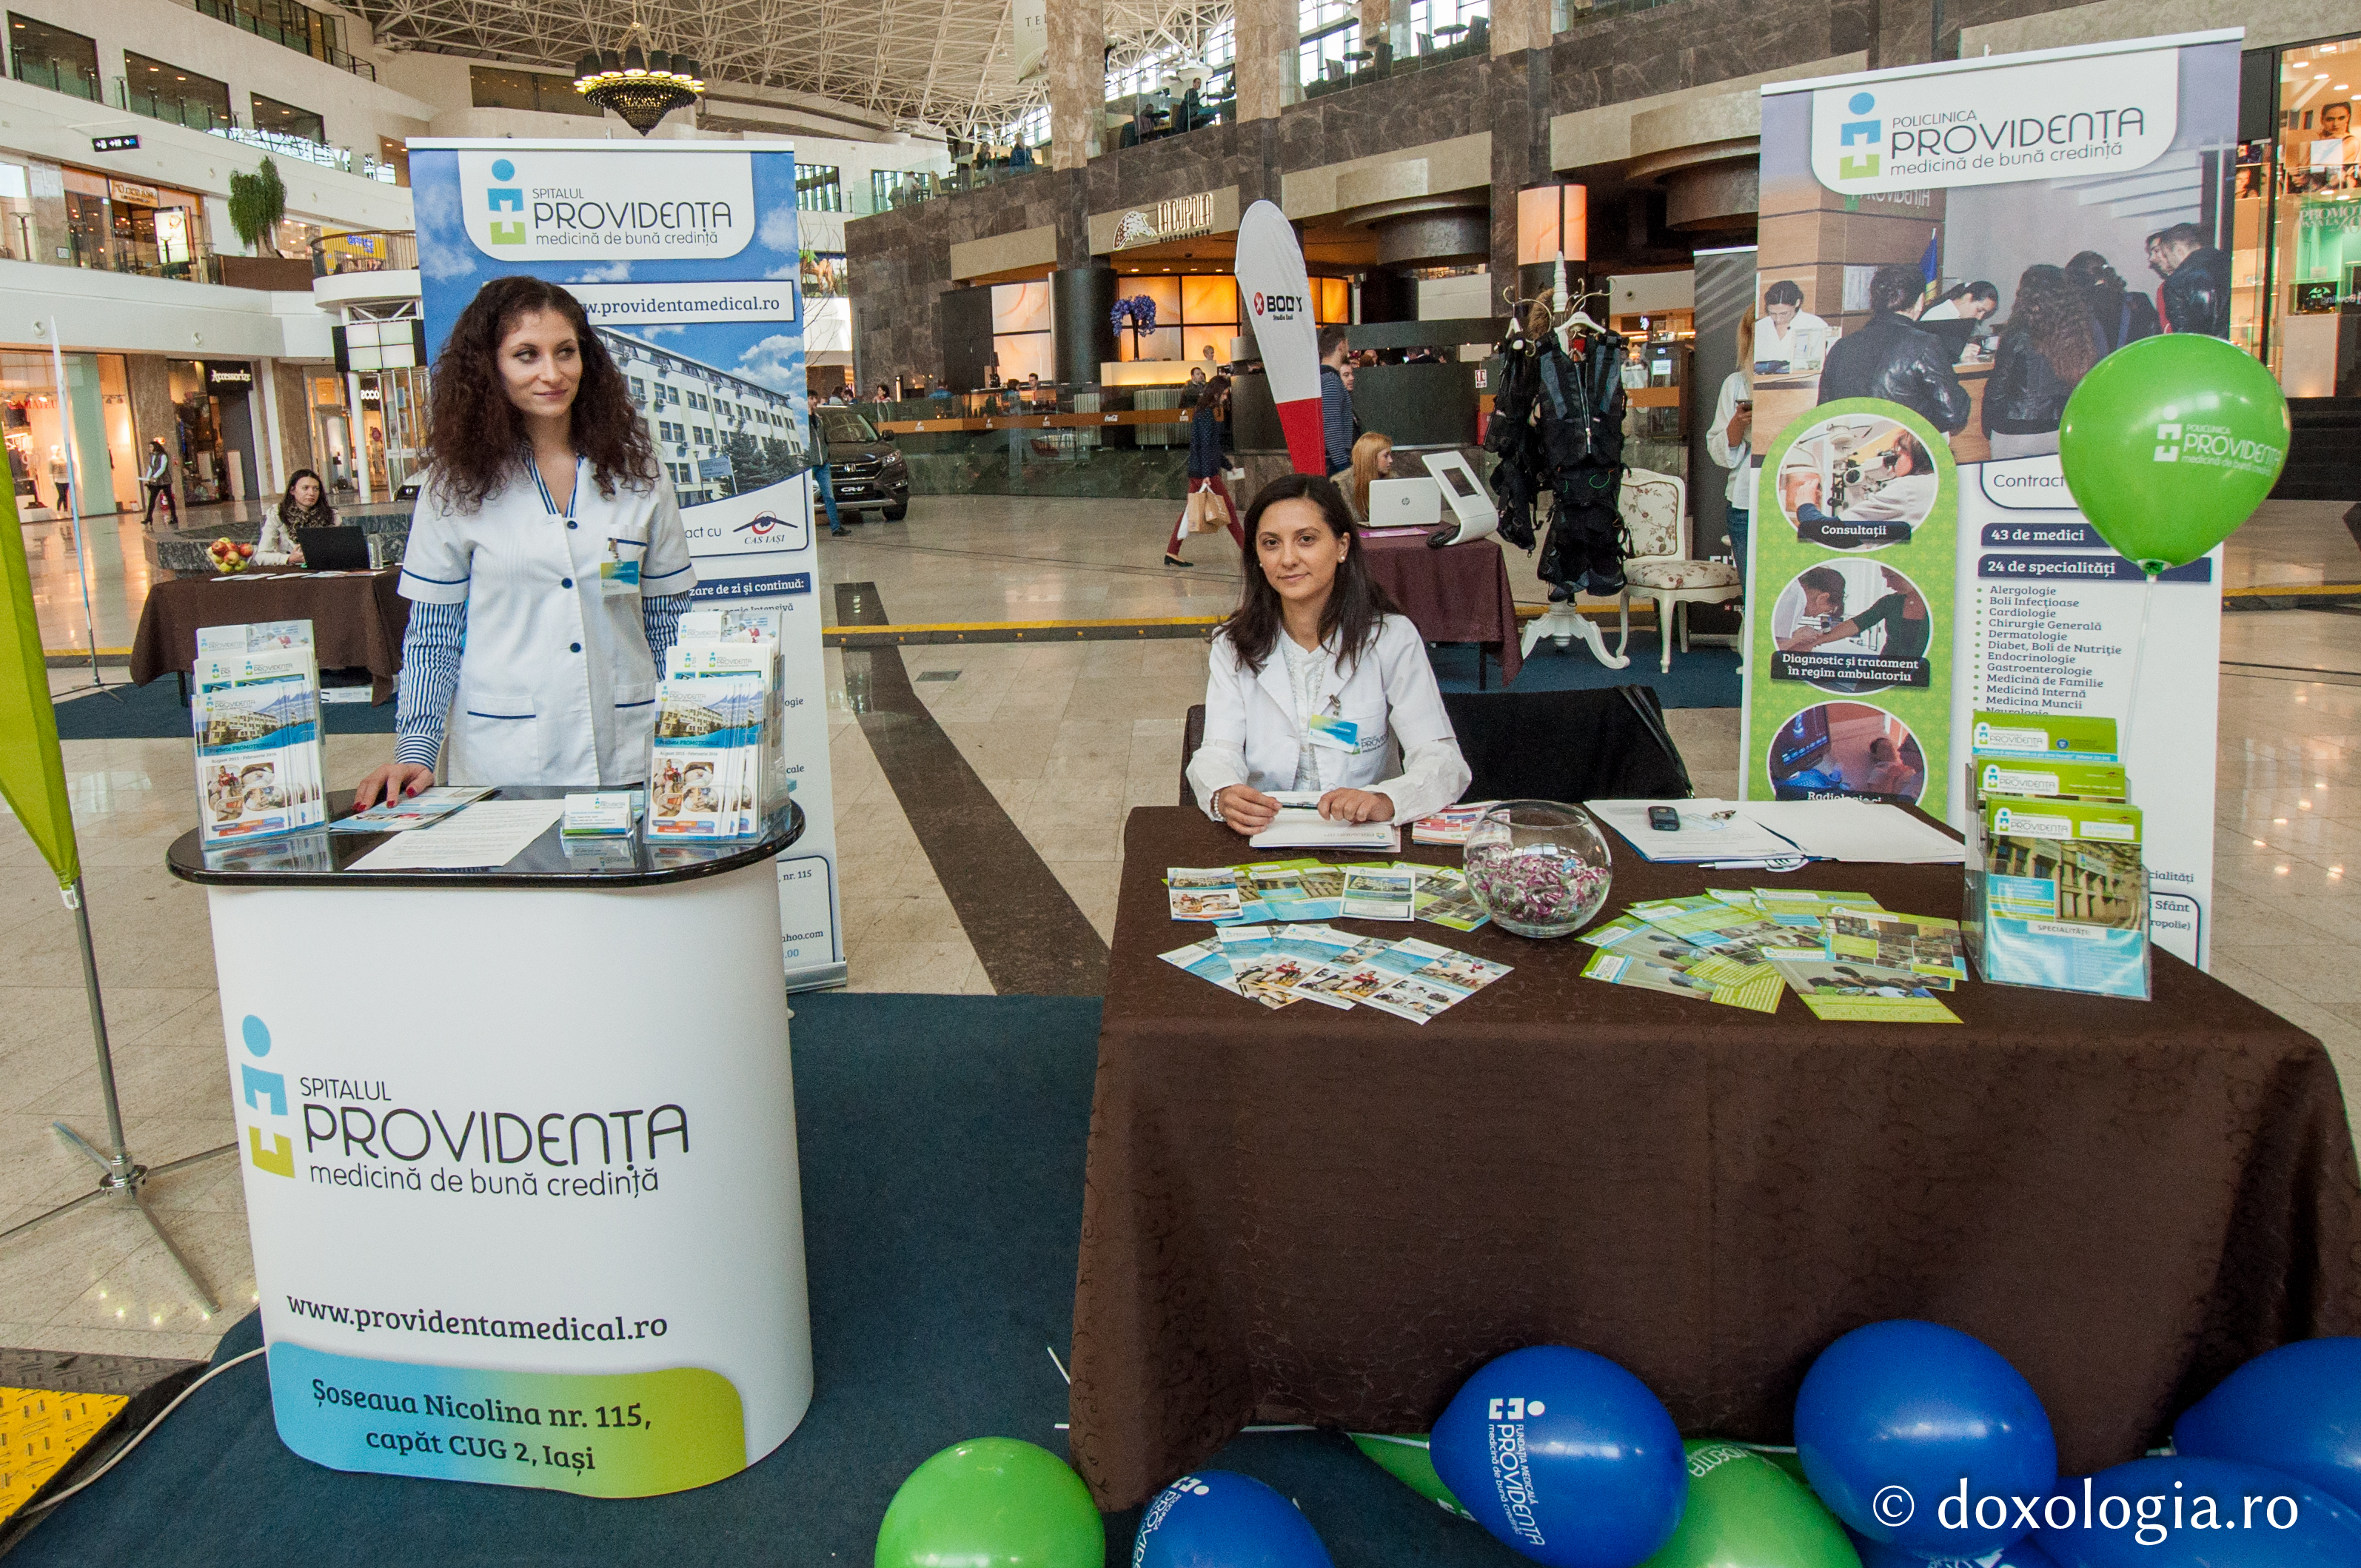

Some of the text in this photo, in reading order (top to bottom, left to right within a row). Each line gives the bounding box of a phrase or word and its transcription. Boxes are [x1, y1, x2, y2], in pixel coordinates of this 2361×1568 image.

[1892, 110, 1977, 128] POLICLINICA
[1891, 141, 2122, 176] medicină de bună credință
[533, 188, 584, 199] SPITALUL
[1171, 193, 1213, 231] CUPOLA
[536, 230, 717, 246] medicină de bună credință
[1267, 295, 1302, 312] BODY
[707, 527, 722, 537] cu
[1821, 525, 1886, 537] Consultații
[1991, 529, 2084, 541] 43 de medici
[744, 536, 763, 545] CAS
[1988, 560, 2116, 577] 24 de specialități
[716, 584, 729, 594] de
[731, 583, 741, 593] zi
[754, 579, 805, 592] continuă:
[1989, 586, 2056, 597] Alergologie
[1989, 597, 2012, 606] Boli
[1989, 608, 2056, 619] Cardiologie
[1989, 618, 2102, 631] Chirurgie Generală
[1988, 630, 2067, 642] Dermatologie
[1988, 641, 2029, 651] Diabet,
[2032, 643, 2054, 651] Boli
[2057, 643, 2071, 652] de
[1782, 654, 1843, 666] Diagnostic
[1858, 658, 1919, 669] tratament
[1988, 652, 2076, 664] Endocrinologie
[1788, 666, 1912, 682] în regim ambulatoriu
[1987, 663, 2093, 676] Gastroenterologie
[1986, 674, 2103, 688] Medicină de Familie
[1986, 685, 2086, 698] Medicină Internă
[2041, 698, 2083, 709] Muncii
[798, 869, 811, 879] 115
[2155, 900, 2190, 912] Sfânt
[301, 1077, 392, 1102] SPITALUL
[310, 1165, 659, 1199] medicină de bună credință
[287, 1295, 667, 1341] www.providentamedical.ro
[312, 1378, 652, 1430] Șoseaua Nicolina nr. 115,
[366, 1430, 595, 1476] capăt CUG 2, Iași
[1493, 1466, 1501, 1478] de
